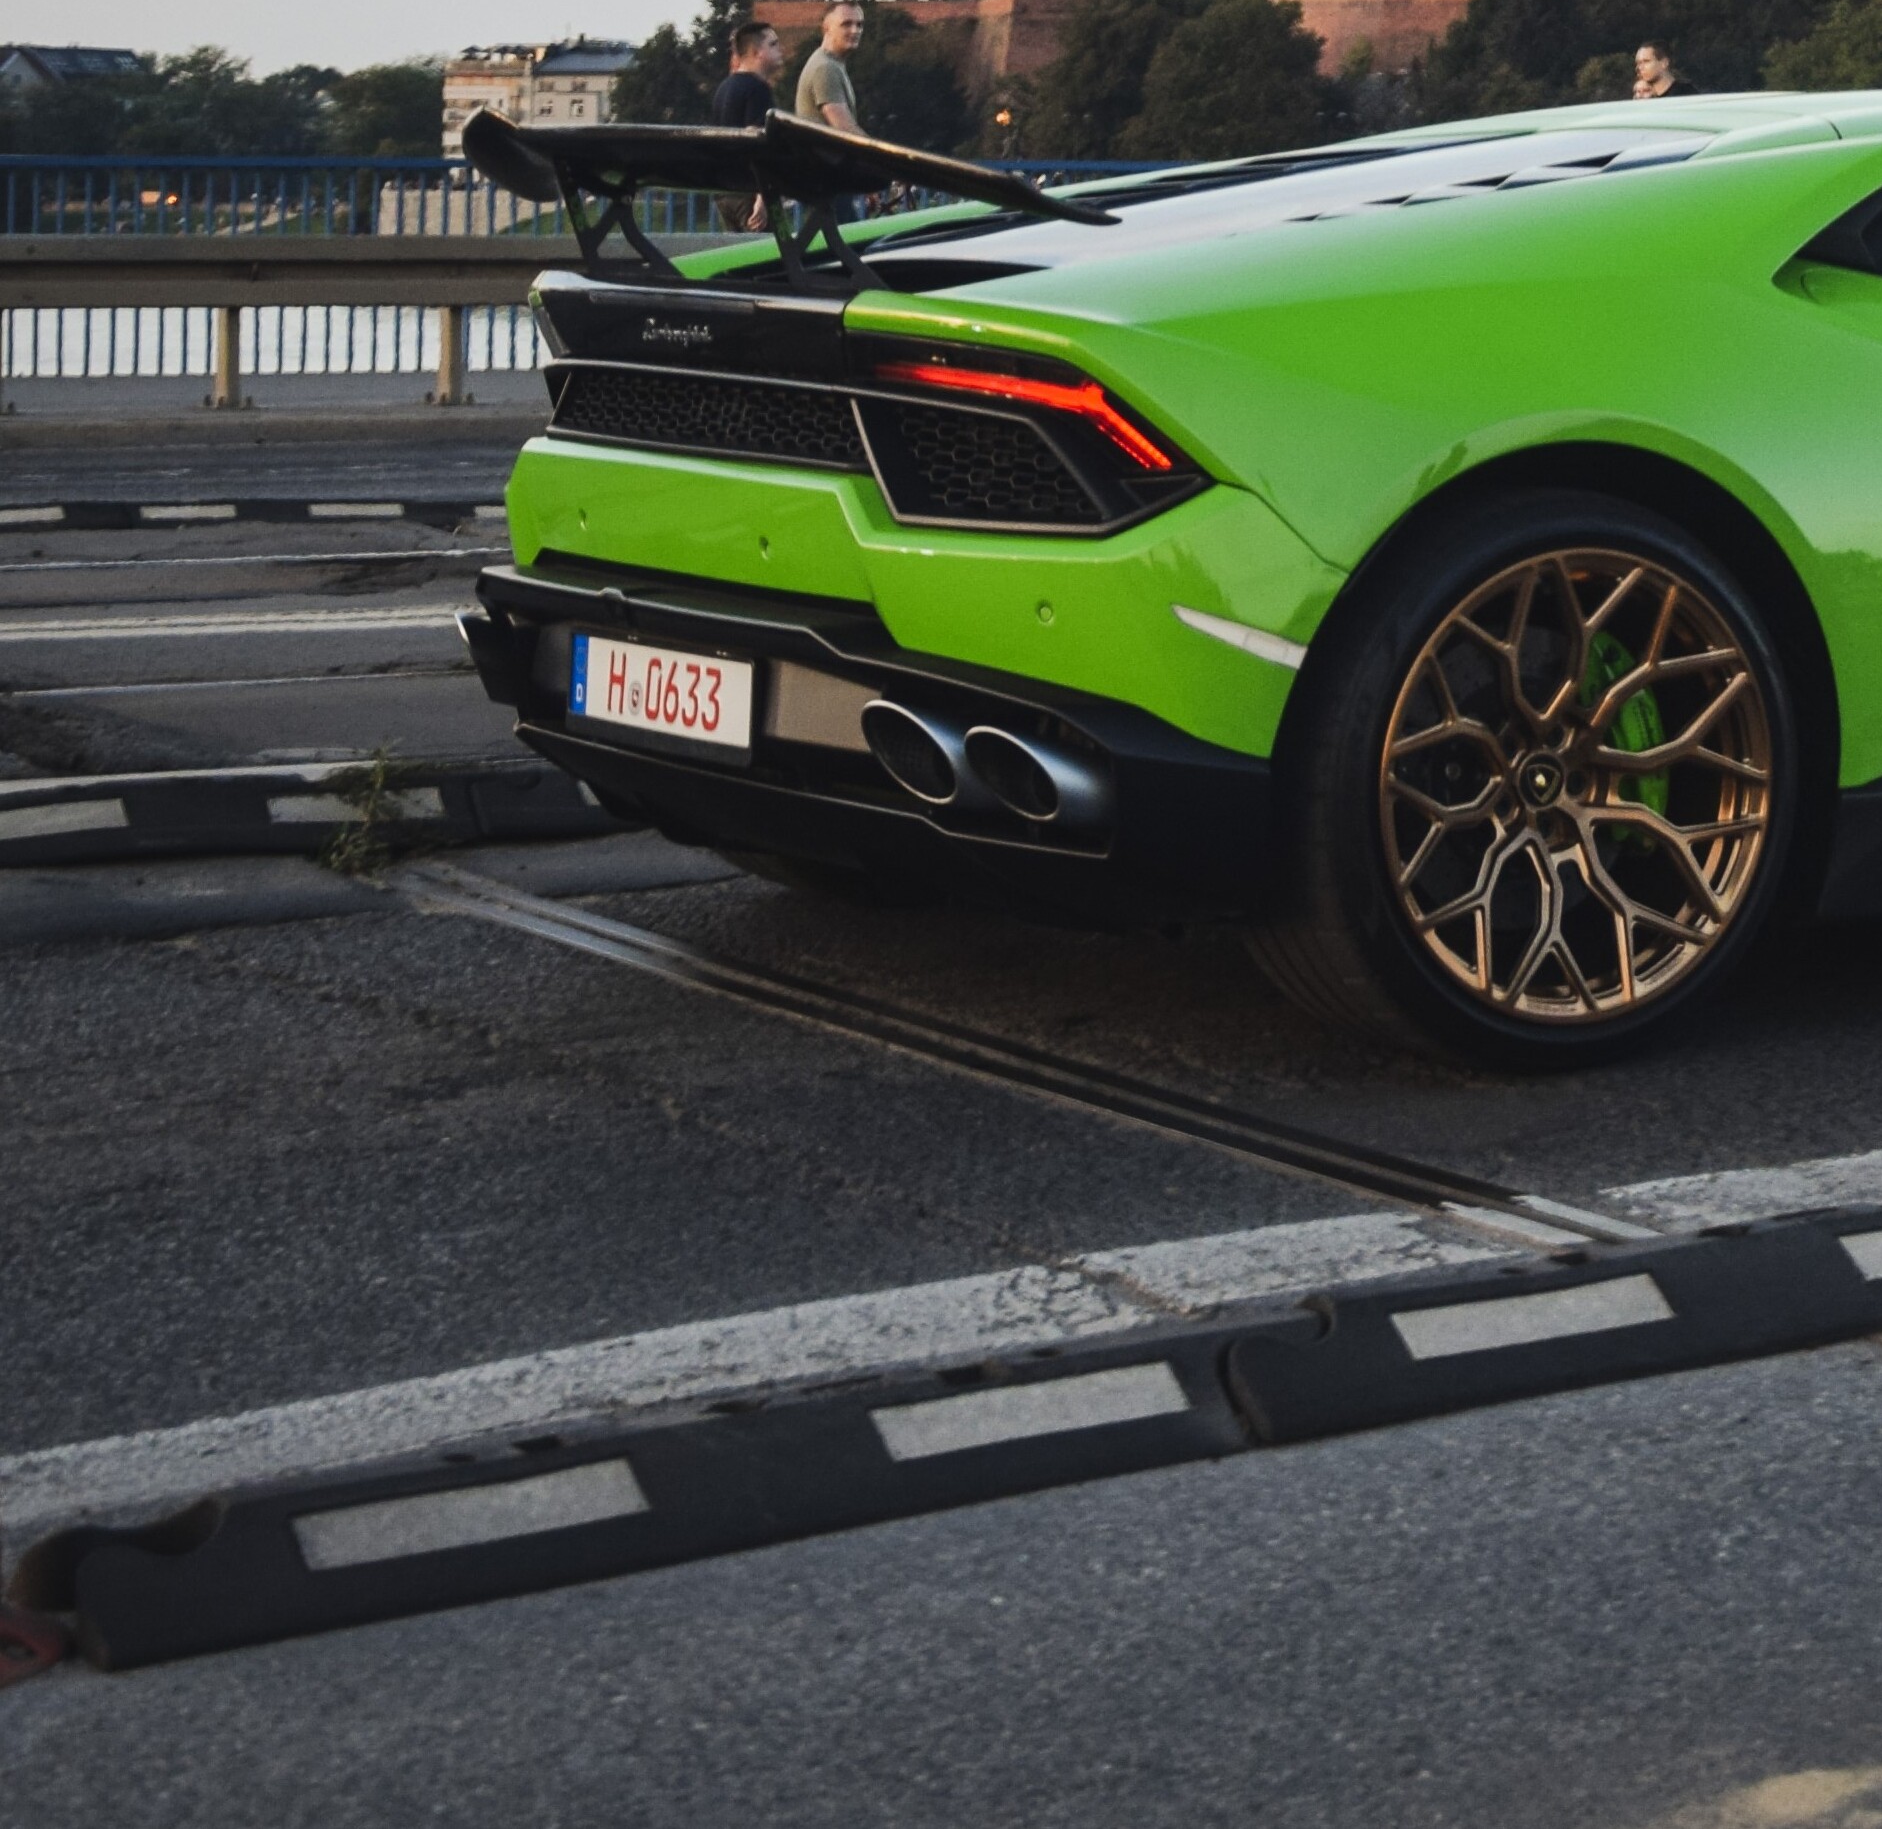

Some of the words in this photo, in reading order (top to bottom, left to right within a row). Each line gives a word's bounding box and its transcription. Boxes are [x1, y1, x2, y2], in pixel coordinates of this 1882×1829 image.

[575, 682, 584, 703] D
[608, 650, 627, 714] H
[645, 658, 721, 731] 0633
